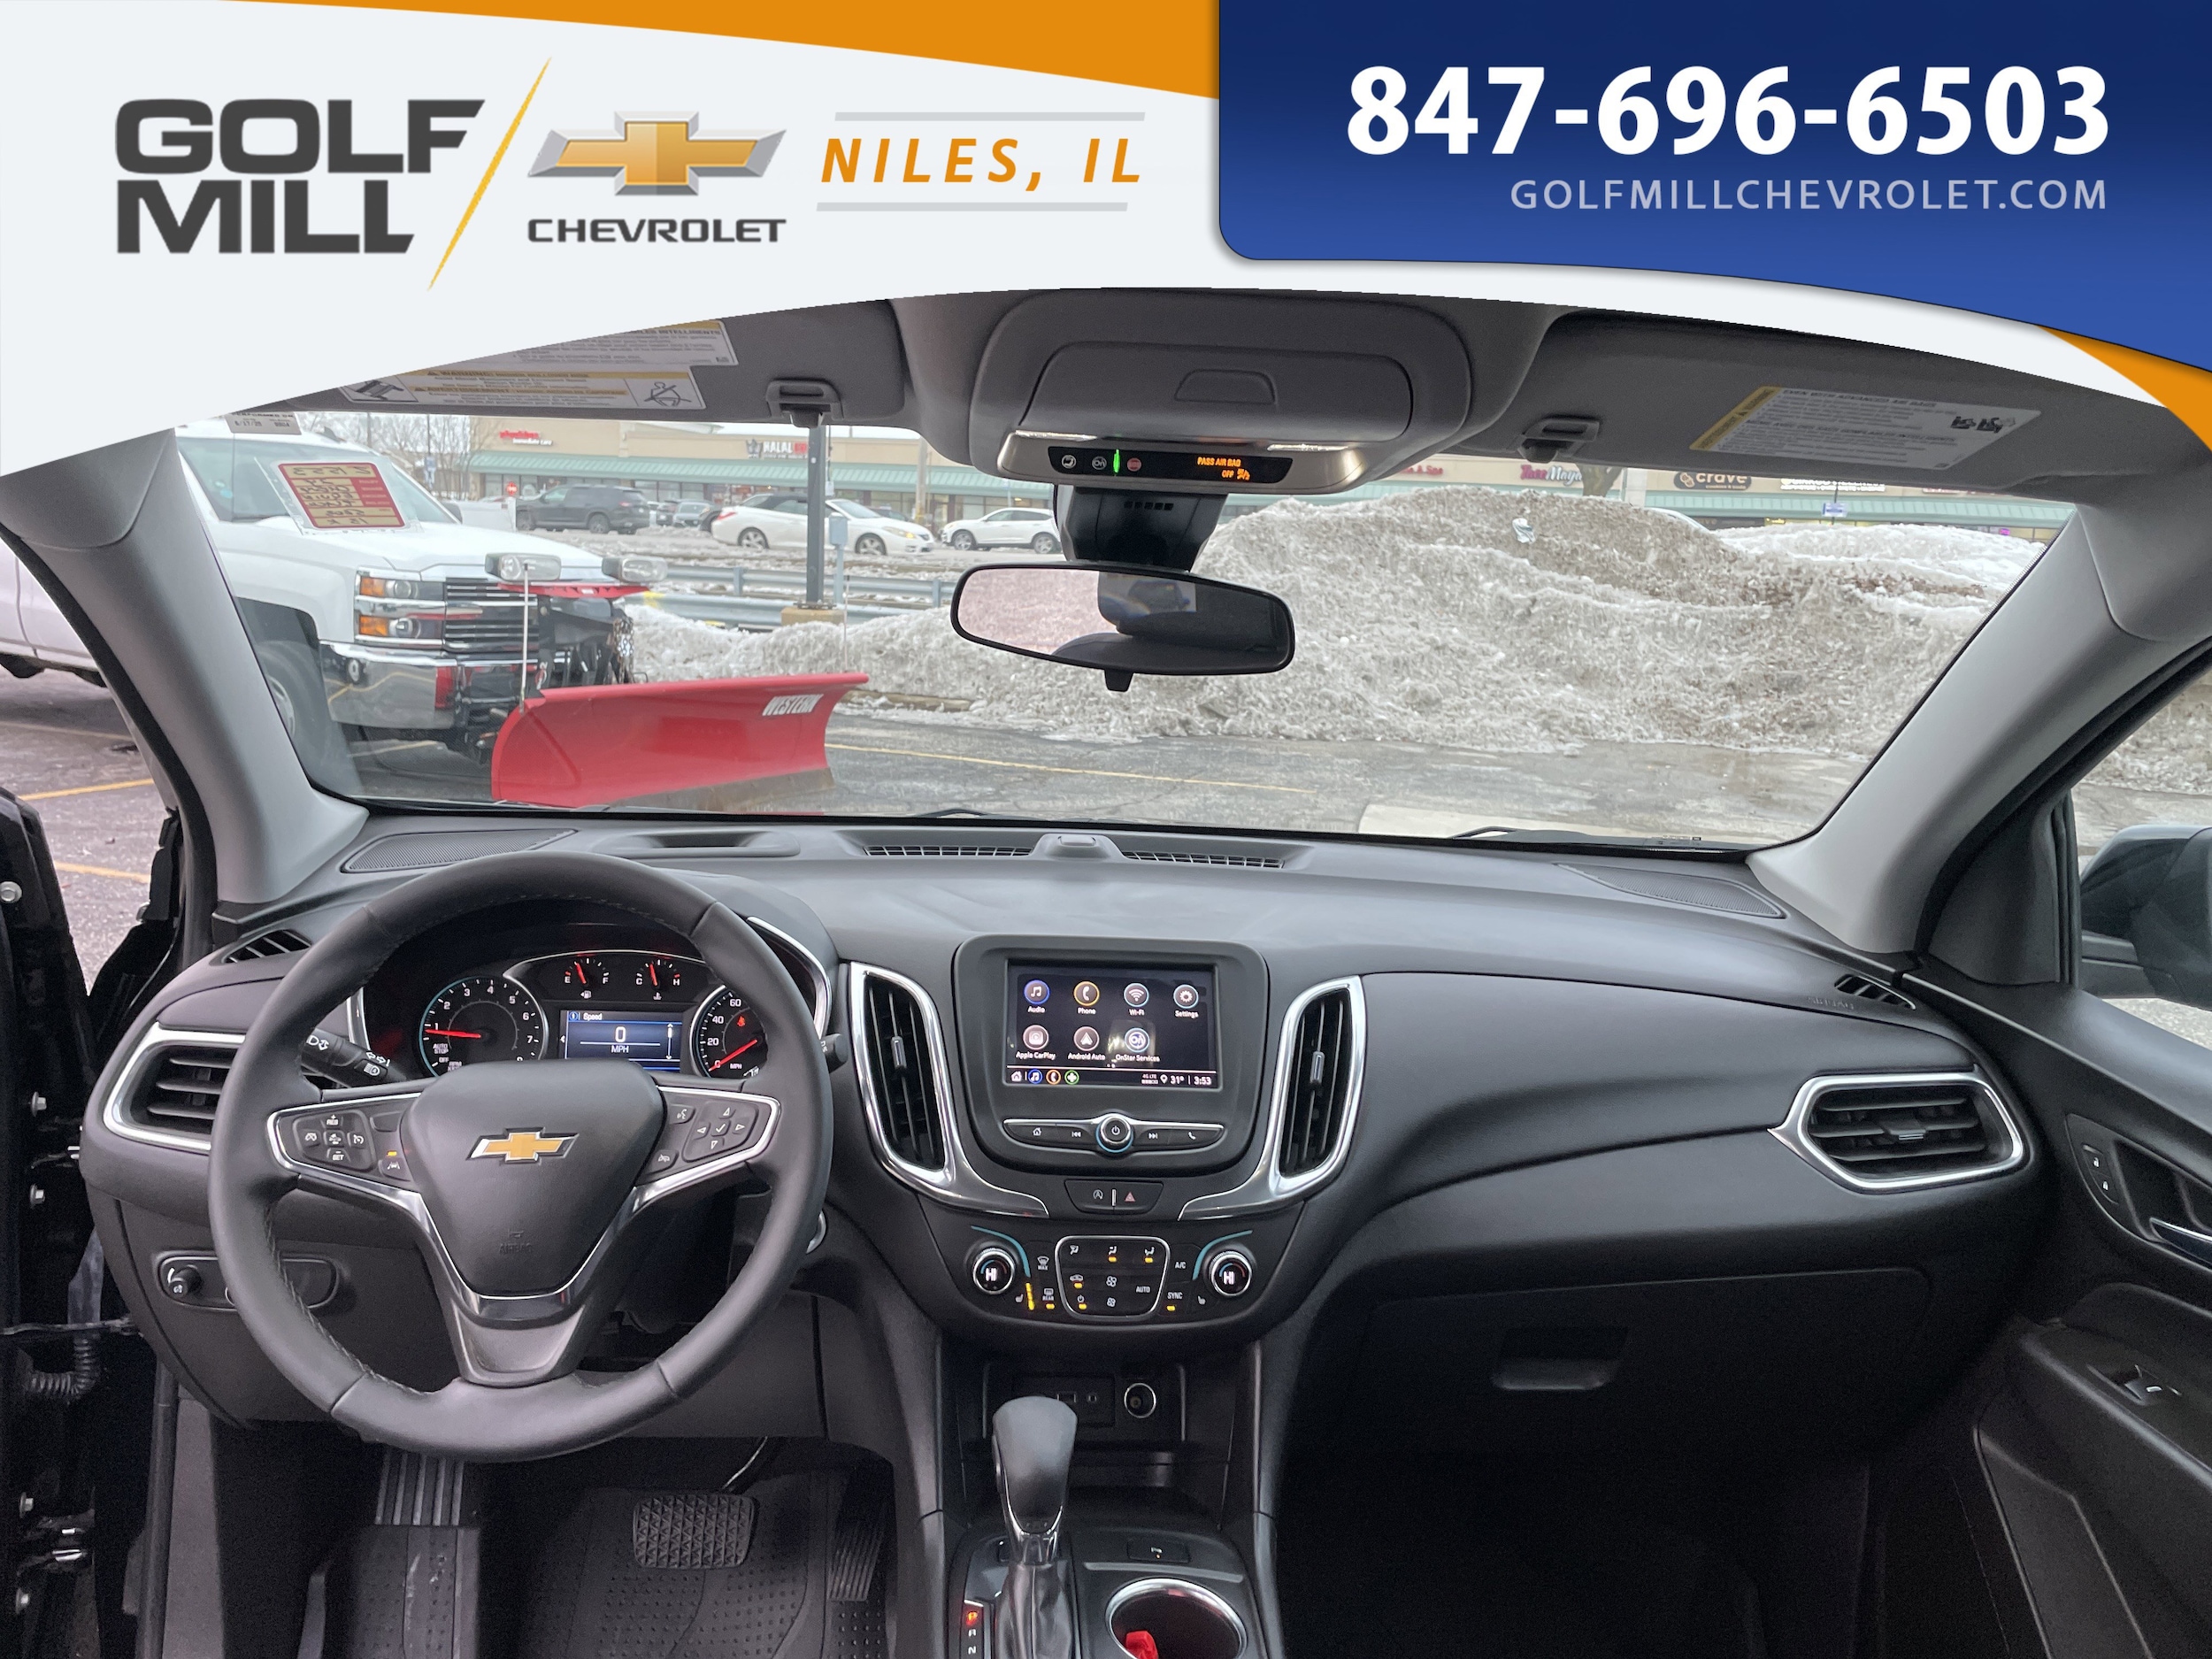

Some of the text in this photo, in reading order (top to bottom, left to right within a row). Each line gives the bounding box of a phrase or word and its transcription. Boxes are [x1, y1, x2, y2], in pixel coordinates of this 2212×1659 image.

[763, 441, 793, 453] HALAL
[1197, 457, 1241, 467] PASS AIR BAG
[1696, 472, 1747, 484] crave
[615, 1026, 626, 1042] 0
[1194, 1076, 1211, 1085] 3:53
[985, 1268, 997, 1281] HI
[1223, 1271, 1234, 1285] HI
[968, 1646, 976, 1655] N
